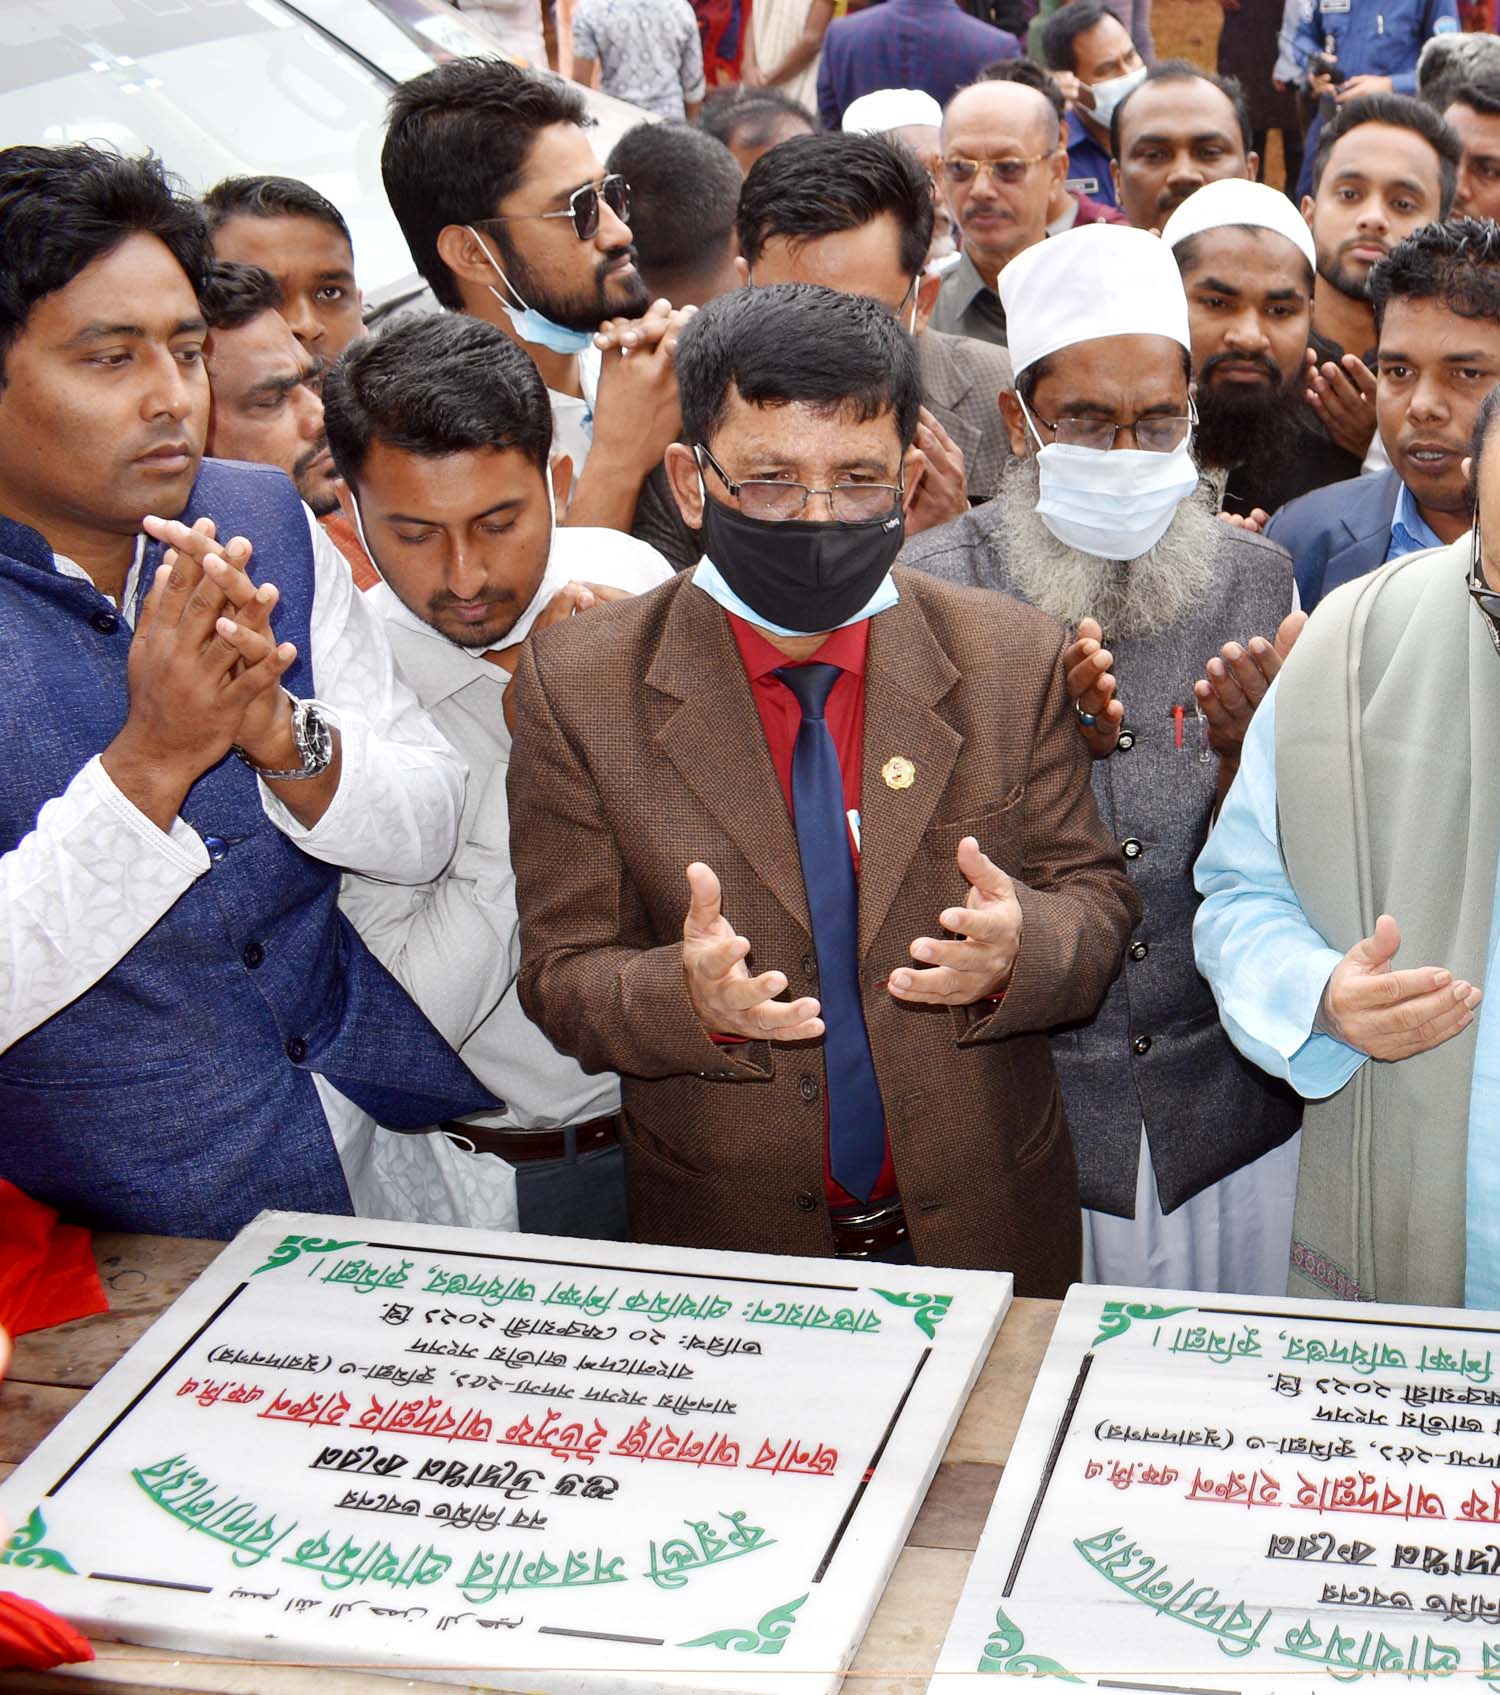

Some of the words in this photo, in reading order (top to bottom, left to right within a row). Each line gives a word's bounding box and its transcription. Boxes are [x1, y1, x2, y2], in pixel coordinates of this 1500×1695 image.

[421, 1264, 536, 1306] অধিদপ্তর,
[540, 1281, 619, 1316] শিক্ষা
[424, 1309, 495, 1330] ২০২১
[619, 1290, 732, 1322] প্রাথমিক
[742, 1300, 882, 1334] বাস্তবায়নে:
[500, 1317, 617, 1341] ফেব্রুয়ারী
[628, 1329, 666, 1345] ২০
[207, 1344, 333, 1375] (মুরাদনগর)
[403, 1338, 479, 1358] সংসদ
[478, 1345, 568, 1370] জাতীয়
[678, 1334, 762, 1357] তারিখ:
[1278, 1331, 1408, 1375] অধিদপ্তর,
[338, 1362, 436, 1387] কুমিল্লা-৩
[574, 1354, 694, 1380] বাংলাদেশ
[1415, 1346, 1494, 1383] শিক্ষা
[175, 1376, 264, 1408] এফ.সি.এ
[579, 1386, 648, 1407] সংসদ
[1314, 1377, 1393, 1399] ২০২১
[256, 1388, 351, 1428] হারুন
[349, 1392, 493, 1443] আবদুল্লাহ
[652, 1393, 737, 1416] মাননীয়
[1311, 1405, 1389, 1428] সংসদ
[496, 1408, 608, 1465] ইউসুফ
[1093, 1418, 1234, 1452] (মুরাদনগর)
[1395, 1411, 1484, 1437] জাতীয়
[609, 1416, 740, 1468] আলহাজ্ব
[745, 1438, 839, 1476] জনাব
[1245, 1435, 1358, 1462] কুমিল্লা-৩
[308, 1446, 408, 1478] করেন
[1084, 1457, 1179, 1490] এফ.সি.এ
[412, 1461, 545, 1500] উদ্বোধন
[548, 1473, 619, 1501] শুভ
[1184, 1467, 1282, 1510] হারুন
[1288, 1471, 1447, 1522] আবদুল্লাহ
[131, 1453, 298, 1568] বিদ্যালয়ের
[334, 1489, 421, 1517] ভবনের
[424, 1501, 505, 1531] নির্মিত
[504, 1508, 547, 1531] নব
[281, 1530, 453, 1590] প্রাথমিক
[1265, 1532, 1377, 1568] করেন
[455, 1547, 627, 1604] সরকারি
[1072, 1526, 1272, 1658] বিদ্যালয়ের
[1317, 1583, 1414, 1612] ভবনের
[1273, 1618, 1460, 1683] প্রাথমিক
